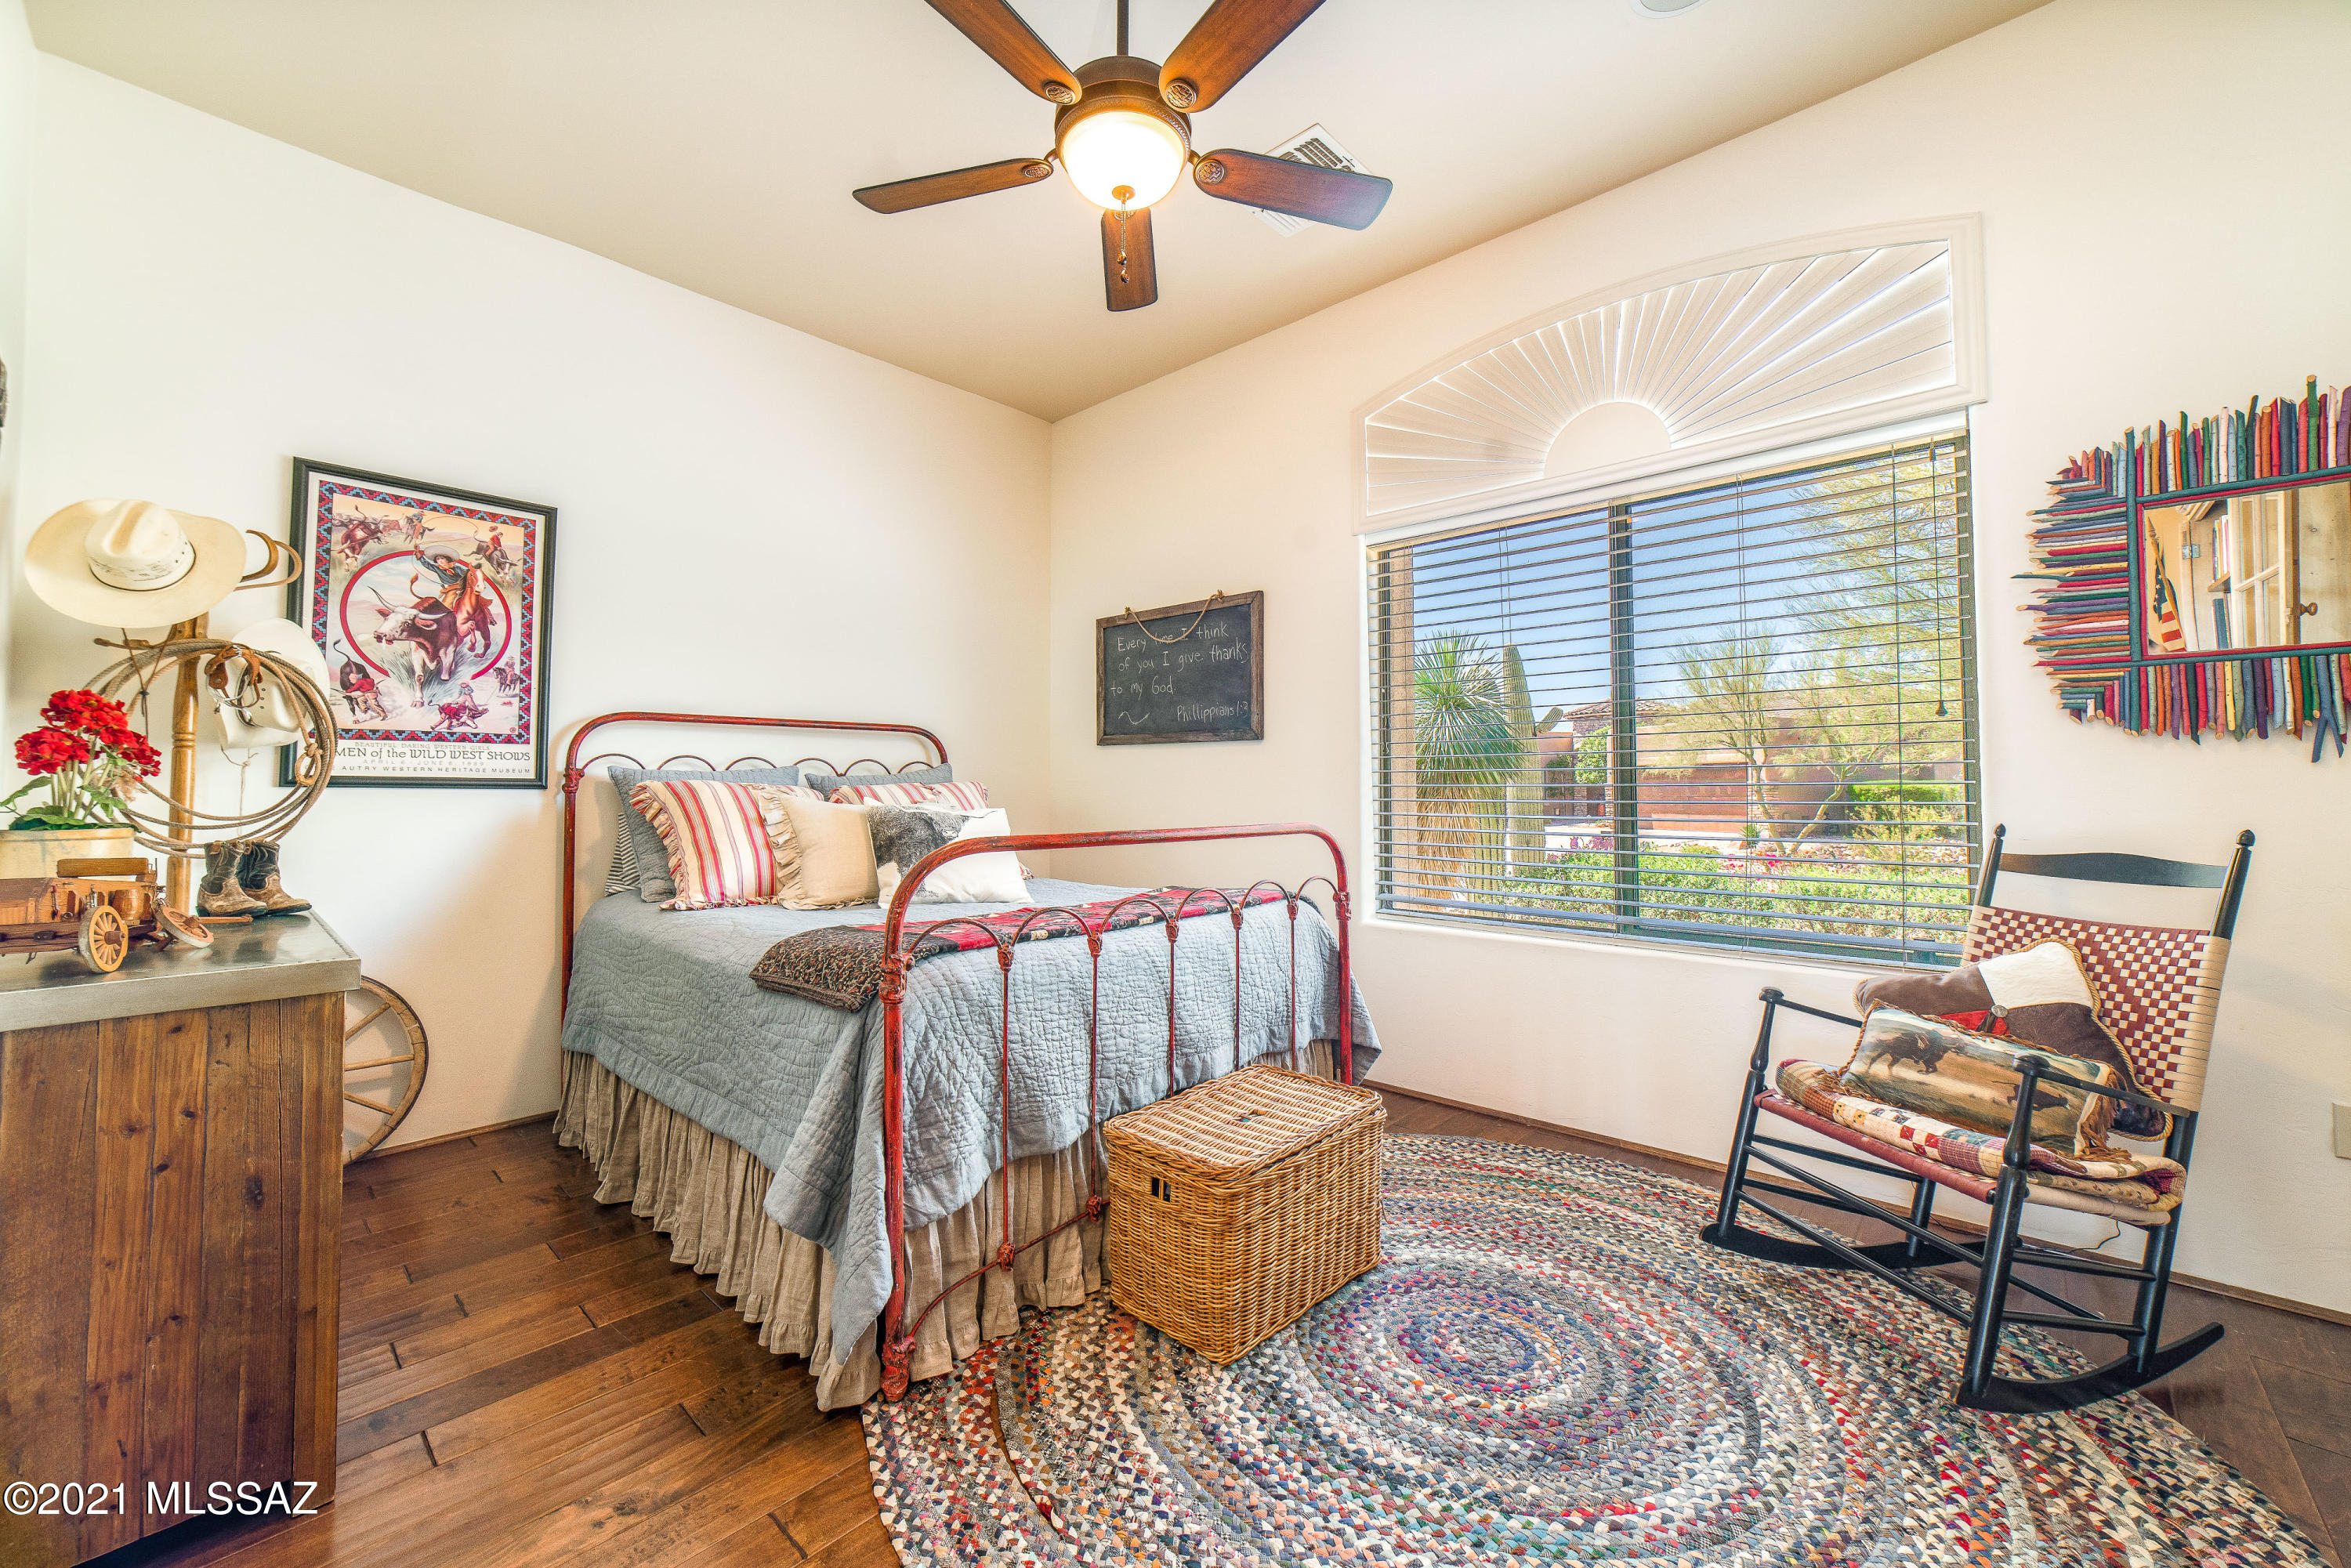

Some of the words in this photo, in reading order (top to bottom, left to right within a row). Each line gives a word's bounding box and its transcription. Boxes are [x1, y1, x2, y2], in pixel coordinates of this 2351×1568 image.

[1118, 637, 1147, 653] Every
[1180, 628, 1188, 641] I
[1196, 621, 1229, 639] think
[1118, 657, 1130, 672] of
[1136, 659, 1154, 674] you
[1162, 650, 1170, 666] I
[1177, 652, 1204, 672] give
[1208, 637, 1249, 664] thanks
[1110, 680, 1123, 697] to
[1130, 683, 1143, 701] my
[371, 748, 382, 759] of
[386, 748, 407, 758] the
[409, 749, 447, 759] WILD
[450, 750, 485, 760] WEST
[487, 751, 531, 761] SHOWS
